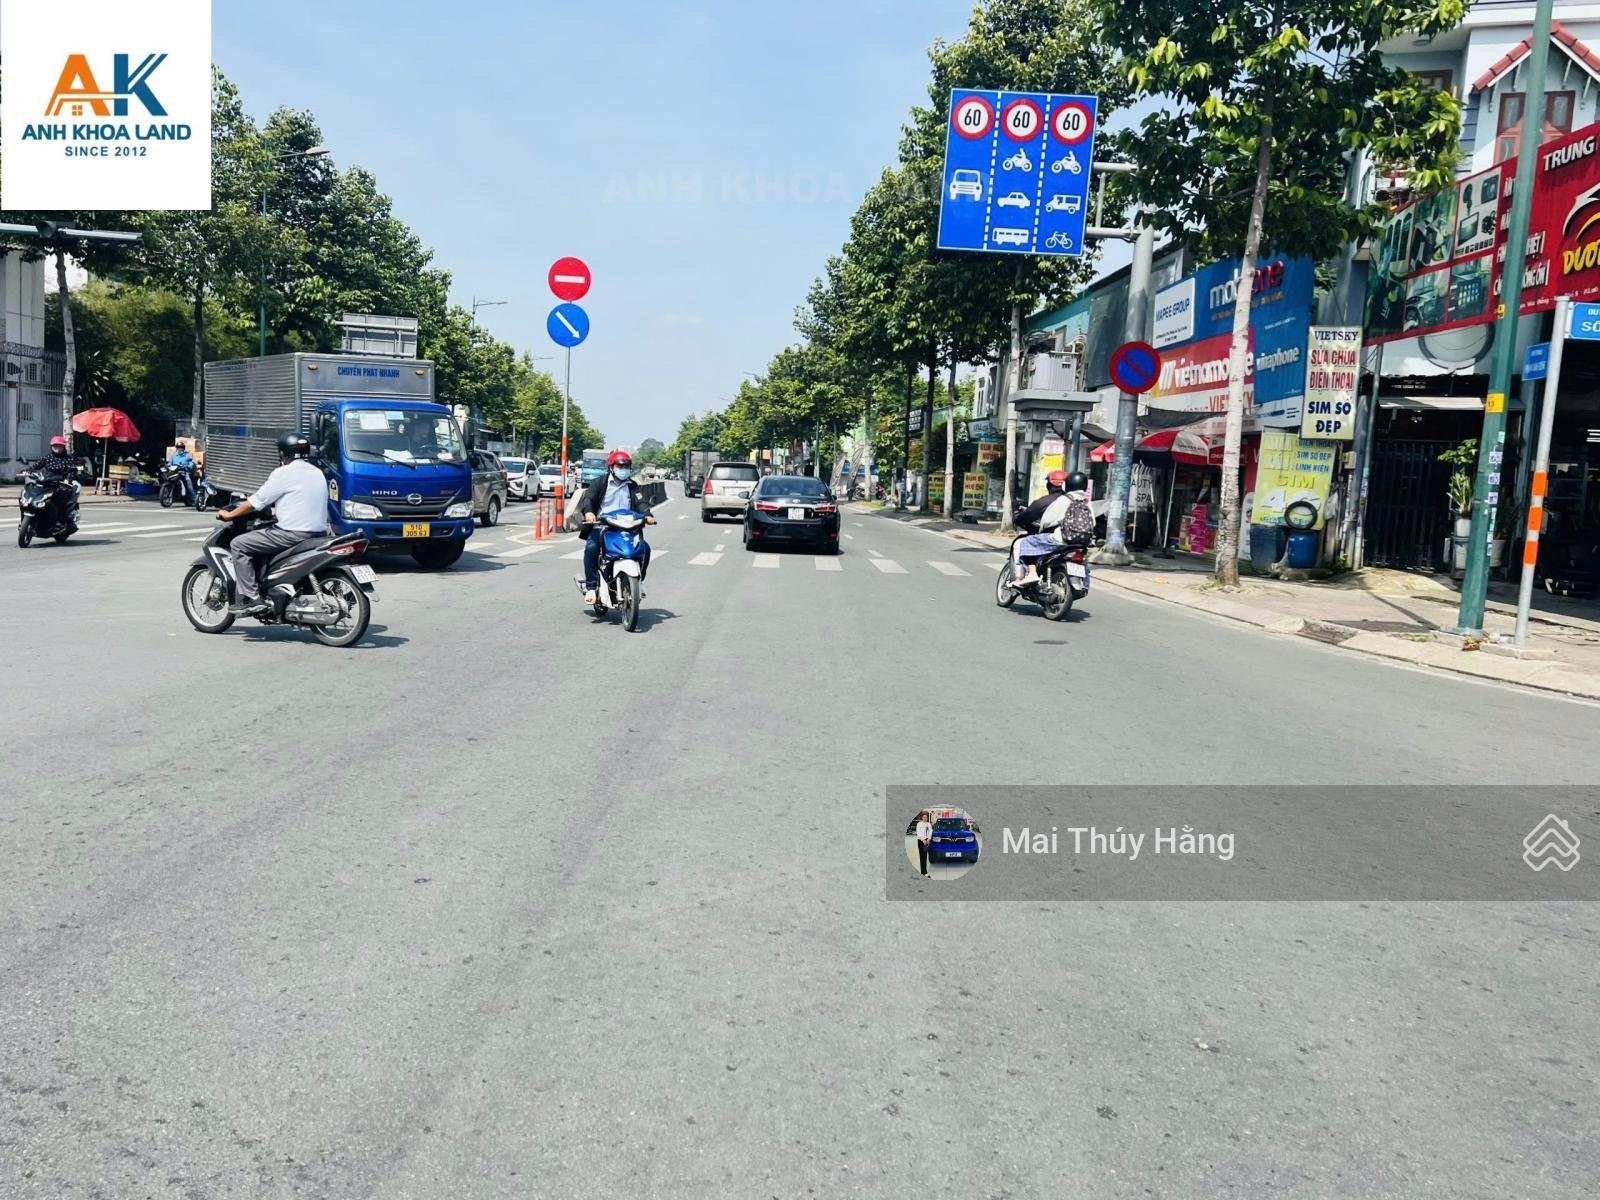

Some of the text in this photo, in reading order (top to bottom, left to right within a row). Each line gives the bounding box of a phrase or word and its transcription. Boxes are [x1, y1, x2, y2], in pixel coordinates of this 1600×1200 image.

[964, 108, 981, 126] 60
[1013, 110, 1030, 128] 60
[1063, 113, 1080, 131] 60
[1543, 135, 1595, 172] TRUNG
[1314, 331, 1359, 341] VIETSKY
[1256, 347, 1300, 371] vinaphone
[1308, 401, 1331, 414] SIM
[1316, 420, 1342, 436] ĐẸP
[1276, 475, 1315, 489] SIM
